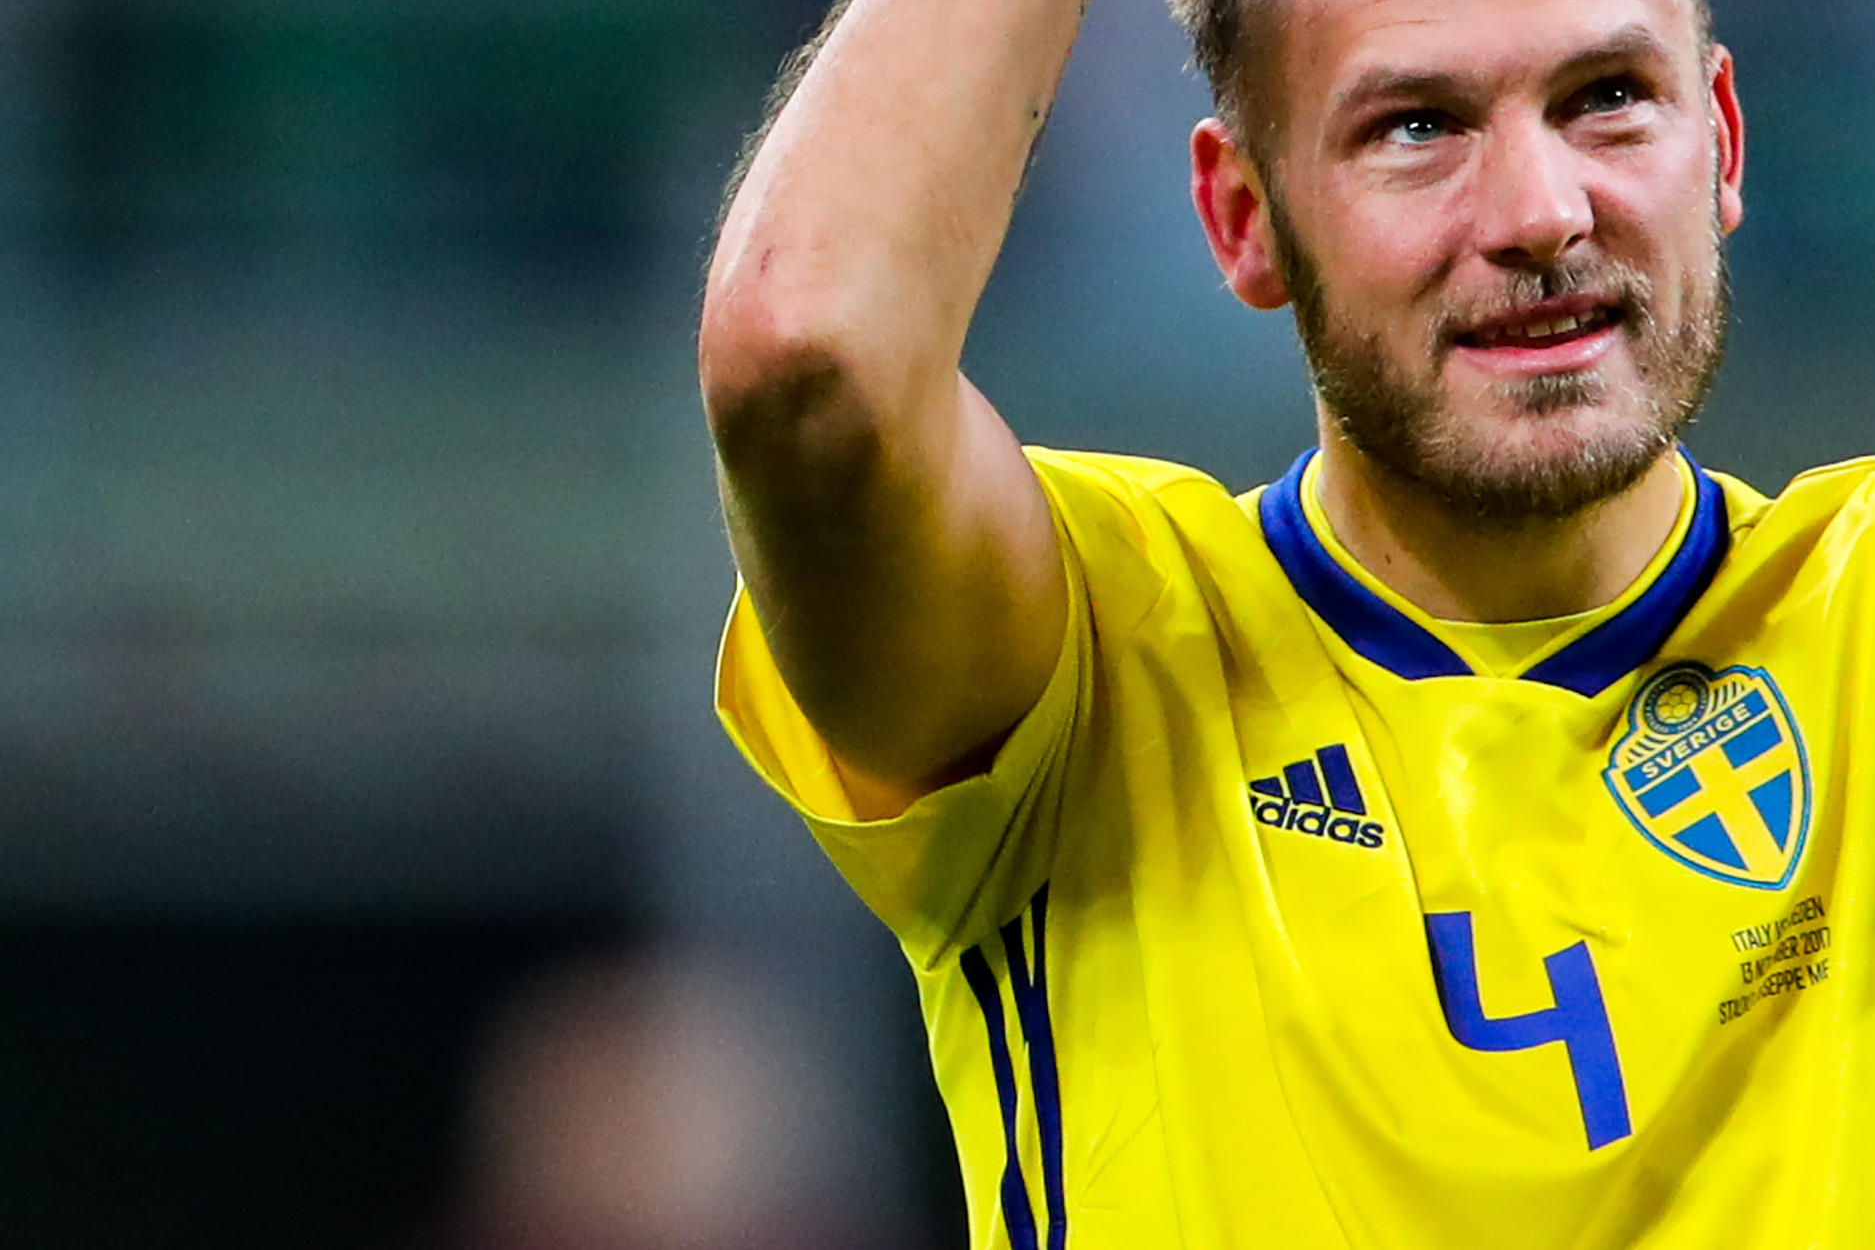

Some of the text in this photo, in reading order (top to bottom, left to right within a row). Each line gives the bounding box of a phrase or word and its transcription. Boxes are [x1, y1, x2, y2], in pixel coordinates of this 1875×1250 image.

[1641, 702, 1752, 779] SVERIGE
[1732, 923, 1771, 952] ITALY
[1801, 927, 1831, 954] 2017
[1424, 910, 1633, 1152] 4
